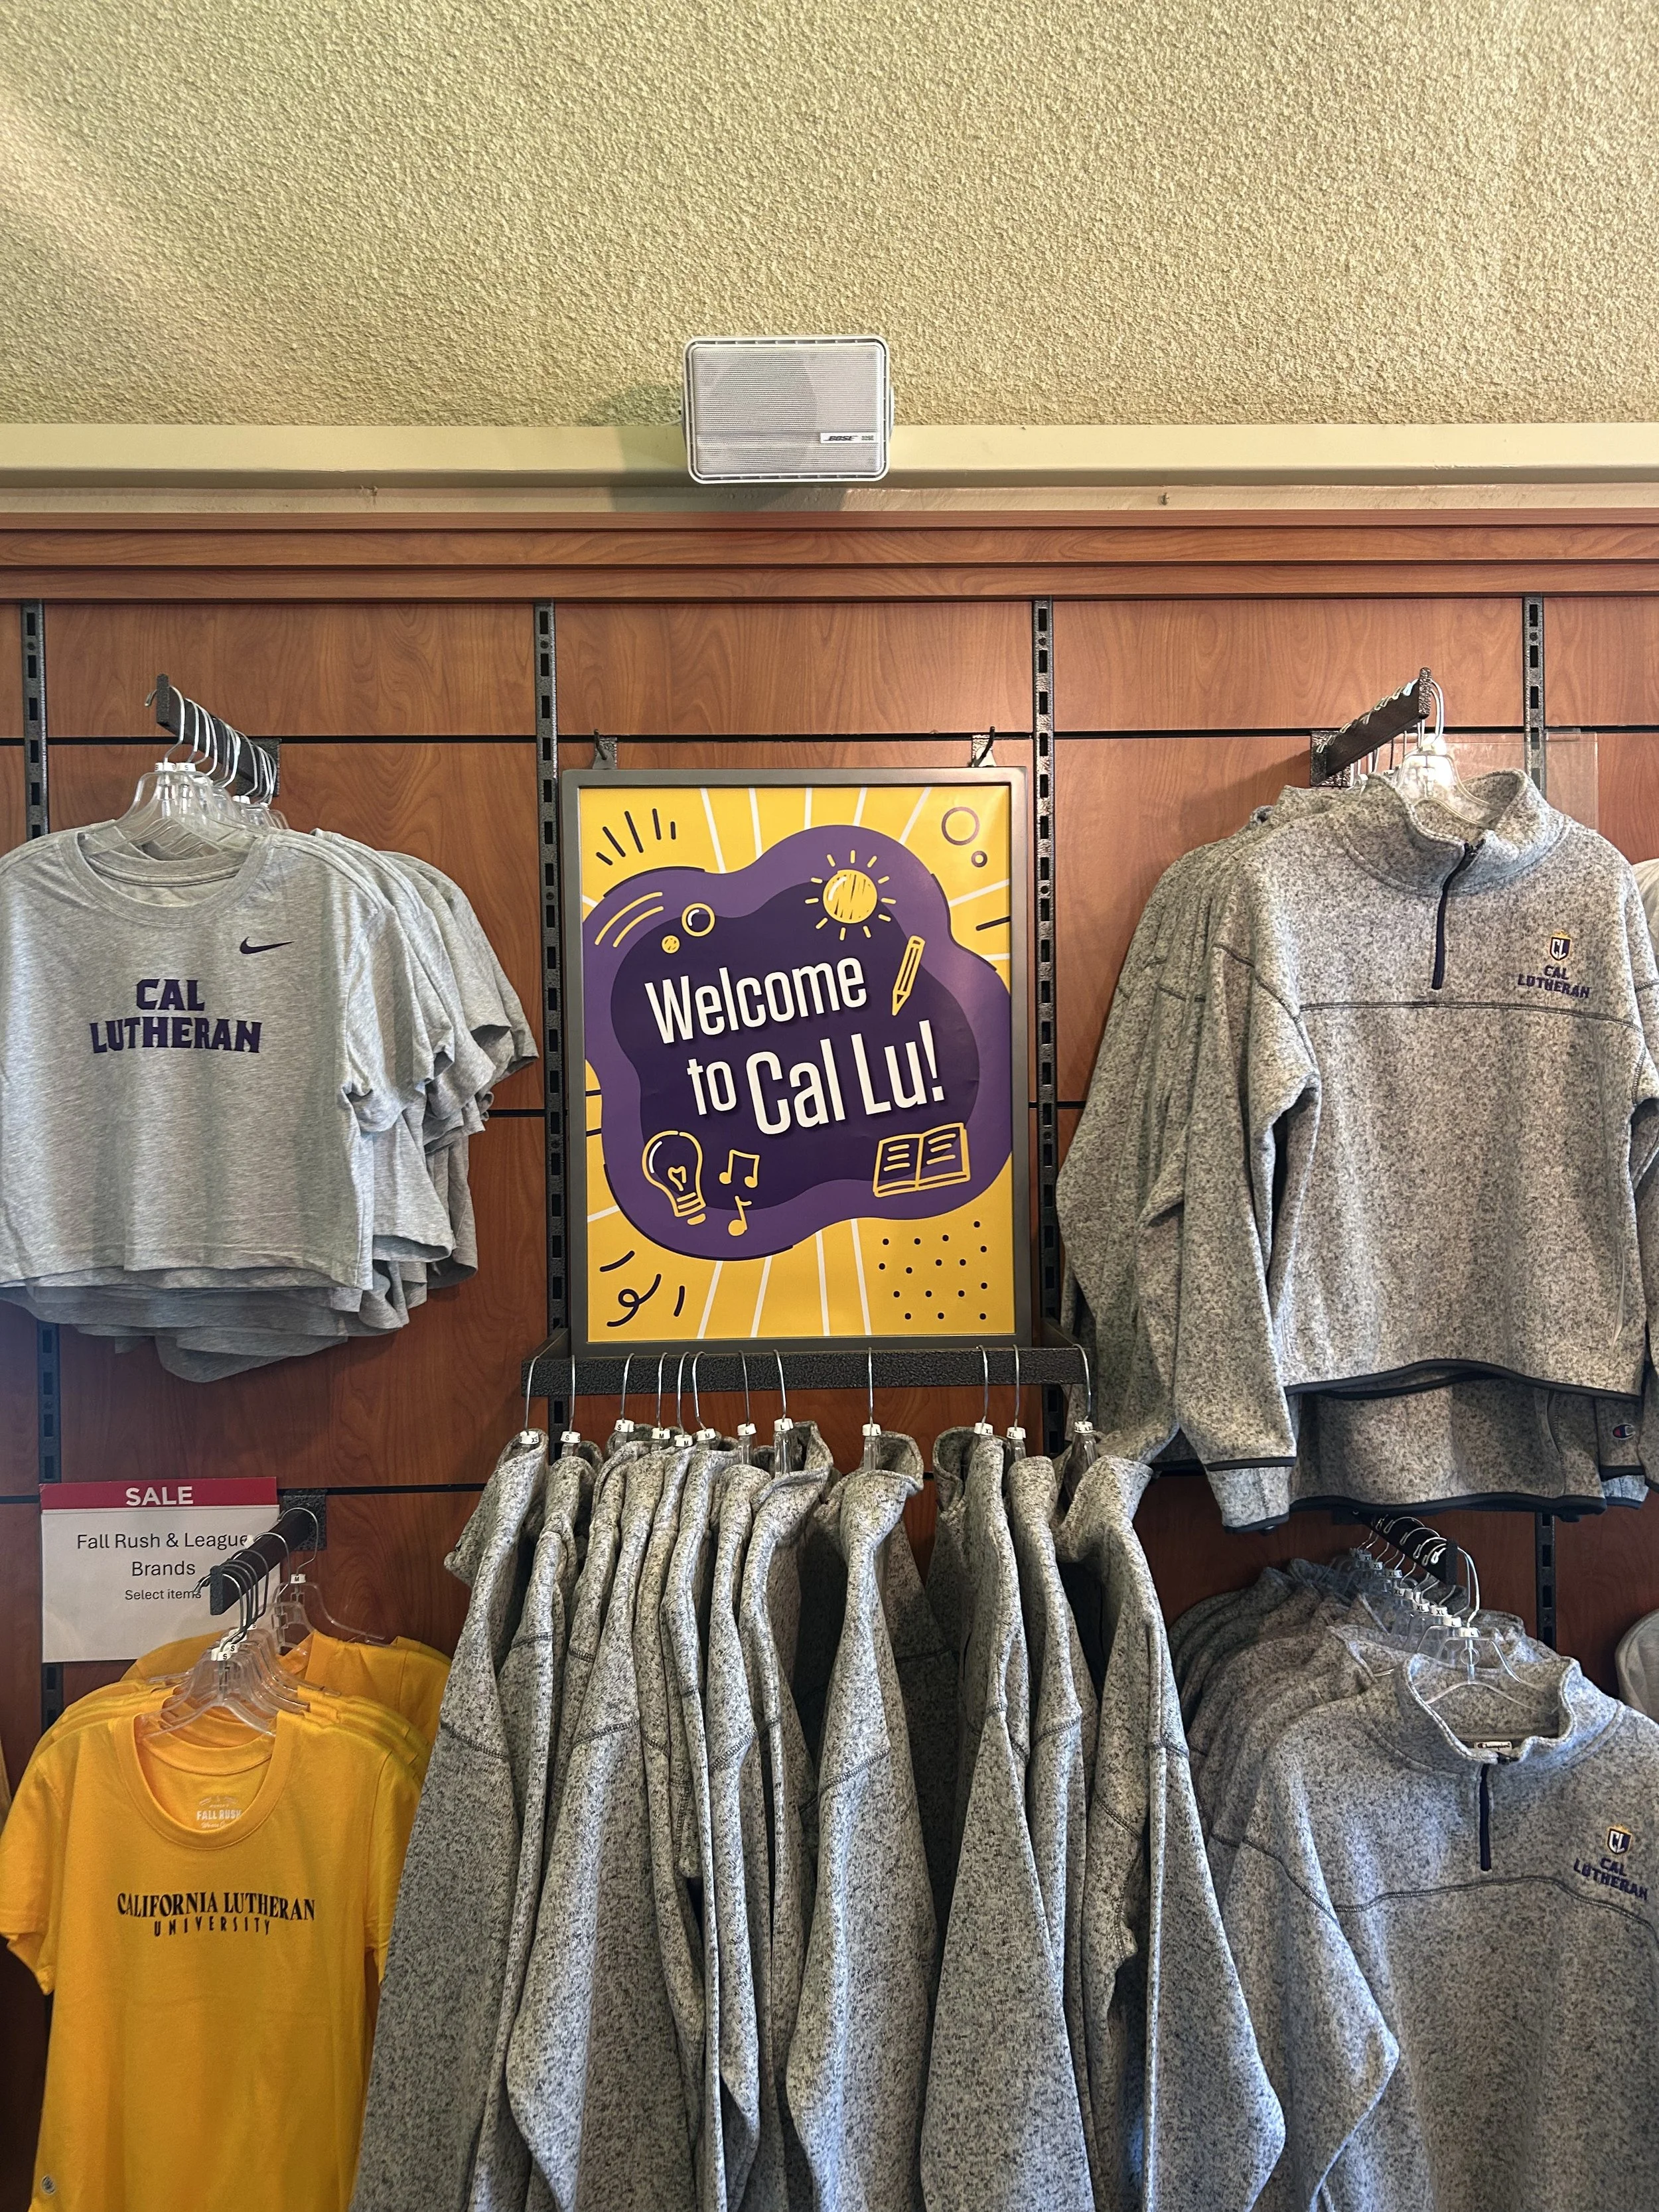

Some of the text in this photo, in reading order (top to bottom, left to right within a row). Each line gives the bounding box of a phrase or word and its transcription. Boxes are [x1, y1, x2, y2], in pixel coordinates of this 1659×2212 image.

[1544, 964, 1569, 980] CAL
[136, 978, 205, 1011] CAL
[1517, 973, 1591, 998] LUTHERAN
[644, 957, 867, 1044] Welcome
[89, 1016, 263, 1054] LUTHERAN
[687, 1019, 945, 1135] to Cal Lu!
[125, 1486, 194, 1507] SALE
[77, 1532, 248, 1550] Fall Rush & League
[132, 1560, 196, 1576] Brands
[125, 1588, 202, 1600] Select items
[196, 1809, 242, 1821] FALL RUSH
[1600, 1857, 1627, 1877] CAL
[1573, 1857, 1648, 1901] LUTHERAN
[117, 1891, 316, 1921] CALIFORNIA LUTHERAN
[153, 1915, 271, 1937] UNIVERSITY
